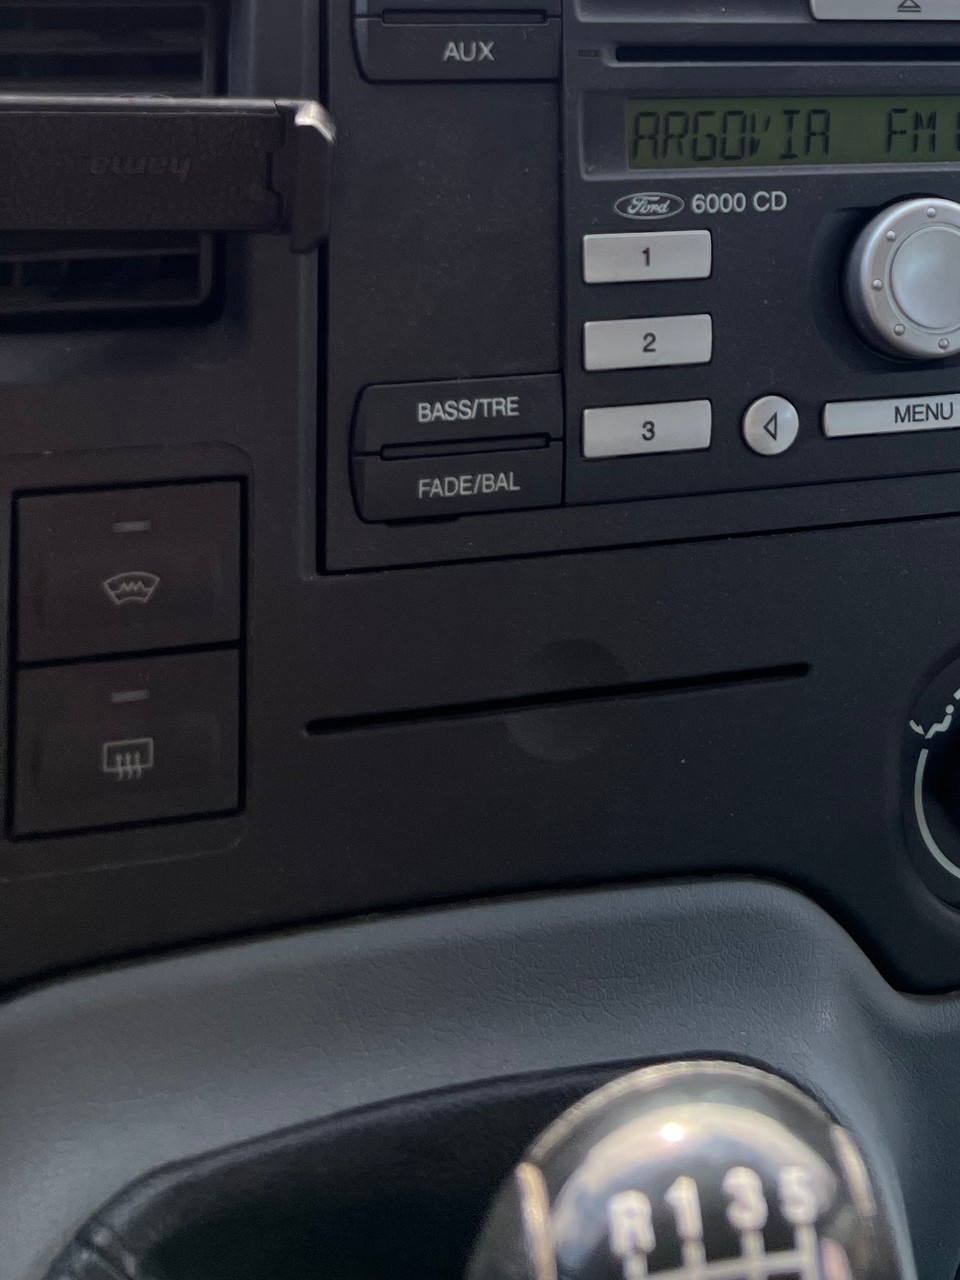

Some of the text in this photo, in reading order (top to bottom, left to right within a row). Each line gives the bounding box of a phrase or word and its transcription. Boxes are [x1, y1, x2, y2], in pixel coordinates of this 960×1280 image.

[442, 41, 495, 62] AUX
[632, 108, 831, 161] ARGOVIA
[627, 190, 788, 215] Ford 6000 CD
[641, 247, 651, 267] 1
[642, 333, 657, 353] 2
[418, 396, 520, 422] BASS/TRE
[894, 402, 954, 424] MENU
[642, 421, 656, 441] 3
[418, 472, 521, 499] FADE/BAL
